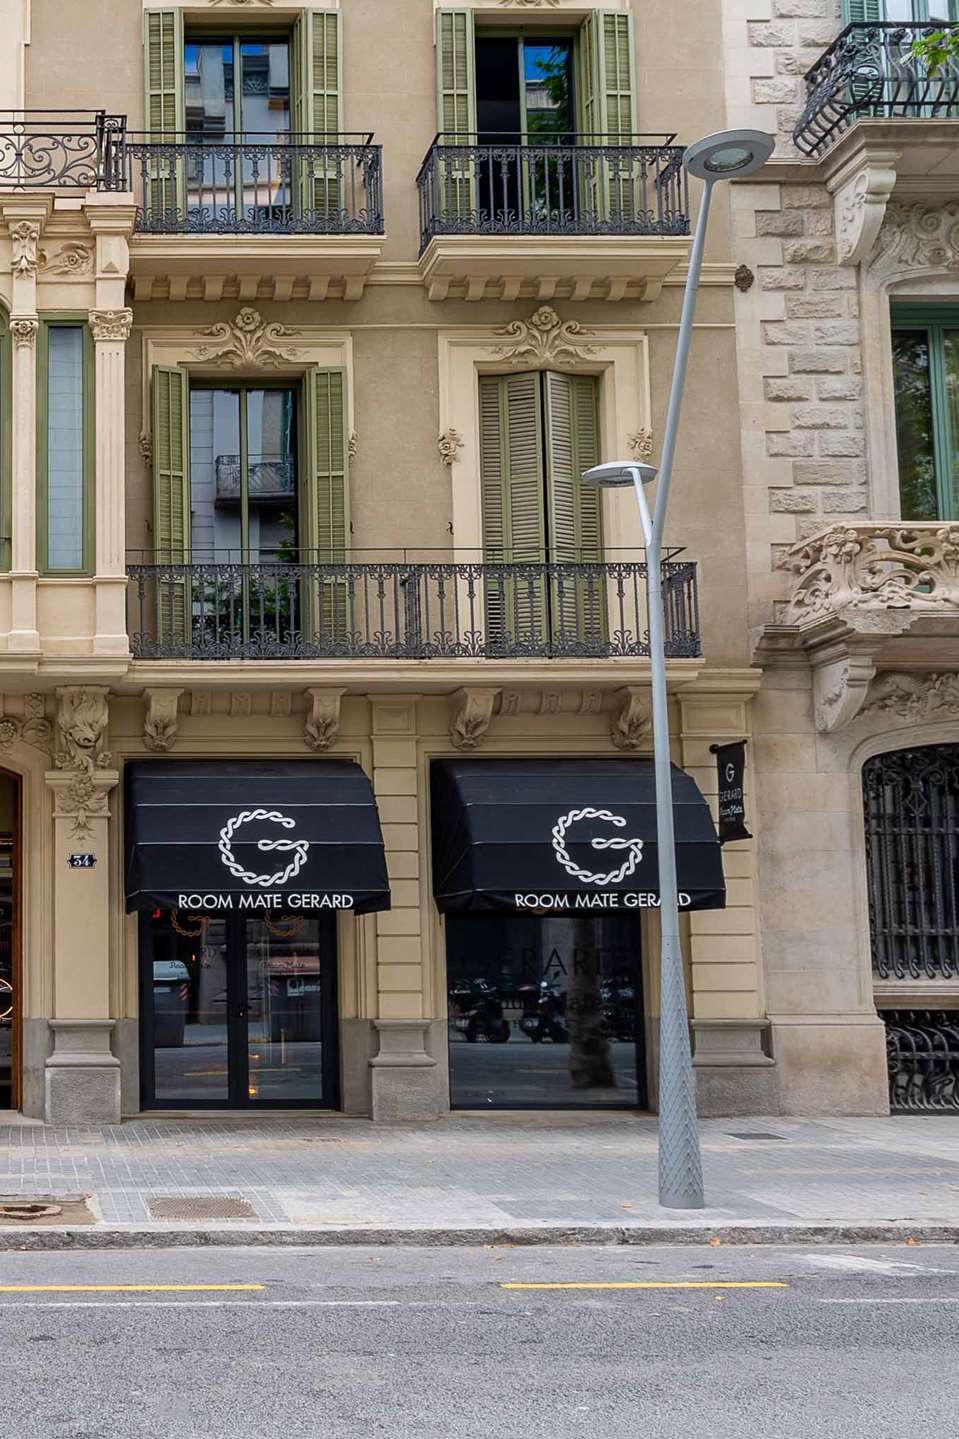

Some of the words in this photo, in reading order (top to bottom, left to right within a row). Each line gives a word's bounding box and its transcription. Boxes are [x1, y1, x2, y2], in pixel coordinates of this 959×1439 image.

[725, 763, 735, 783] G
[178, 894, 233, 909] ROOM
[238, 893, 282, 909] MATE
[287, 893, 354, 909] GERARD
[514, 893, 570, 908] ROOM
[575, 893, 619, 908] MATE
[623, 892, 692, 908] GERD
